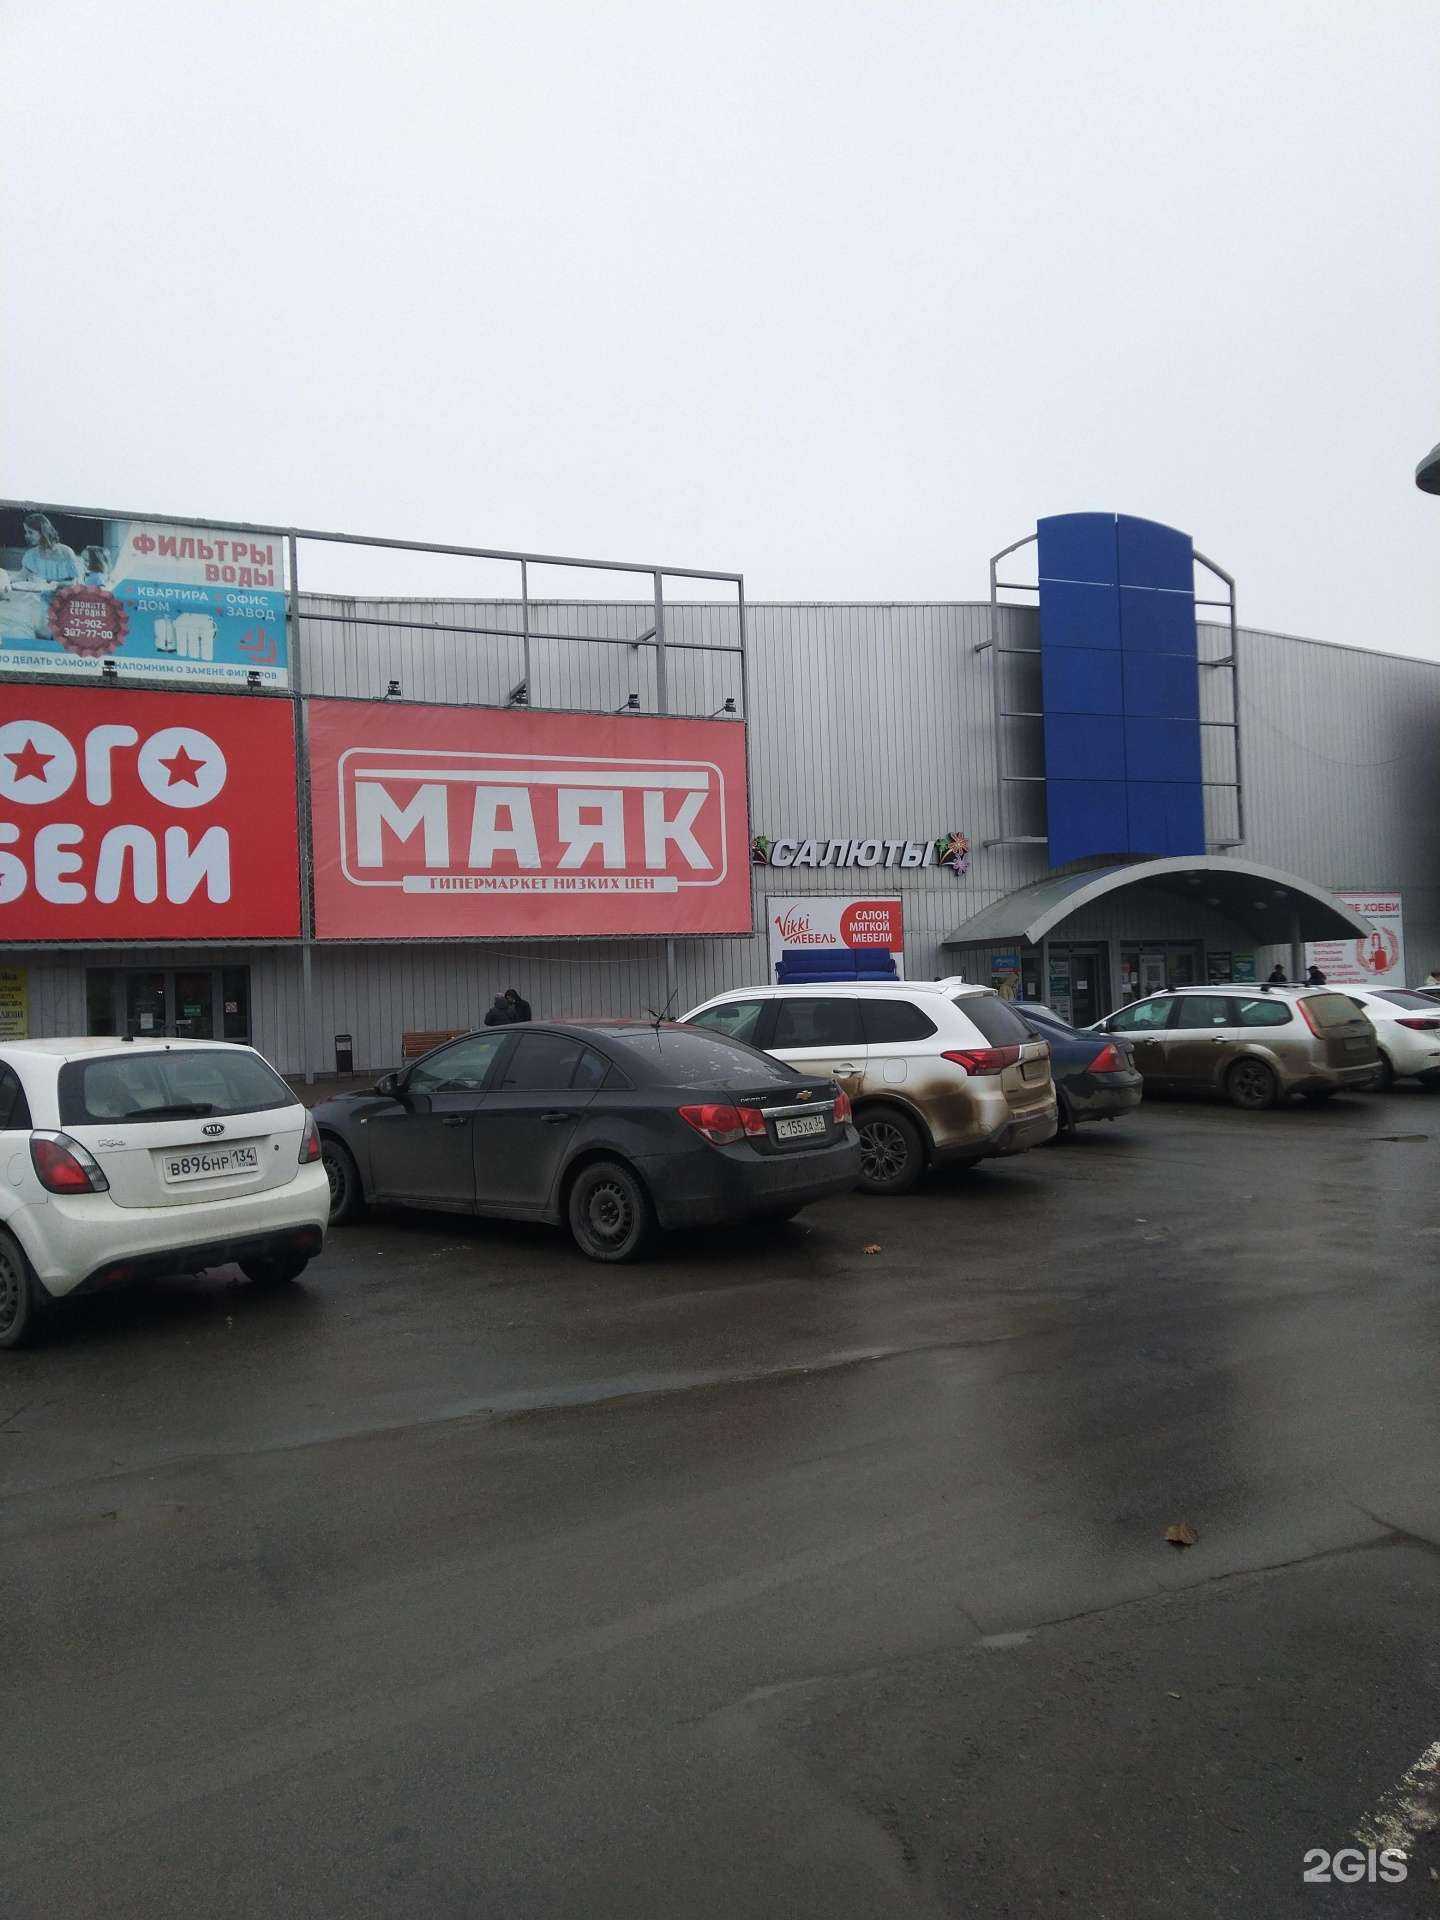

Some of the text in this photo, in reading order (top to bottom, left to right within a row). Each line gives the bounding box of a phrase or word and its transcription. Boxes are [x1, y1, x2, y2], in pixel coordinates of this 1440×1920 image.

[132, 533, 273, 566] ФИЛЬТРЫ
[205, 563, 274, 587] ВОДЫ
[137, 586, 209, 602] КВАРТИРА
[226, 594, 268, 607] ОФИС
[137, 599, 170, 612] ДОМ
[226, 606, 276, 622] ЗАВОД
[12, 656, 51, 666] ДЕЛАТЬ
[55, 659, 99, 669] САМОМУ
[115, 662, 175, 674] НАПОМНИМ
[186, 667, 224, 676] ЗАМЕНЕ
[226, 669, 277, 680] ФИЛРОВ
[355, 782, 713, 869] МАЯК
[771, 839, 936, 867] САЛЮТЫ
[430, 877, 655, 889] ГИПЕРМАРКЕТ НИЗКИХ ЦЕН
[1364, 903, 1400, 912] ХОББИ
[775, 903, 810, 936] Vikki
[855, 911, 889, 920] САЛОН
[849, 920, 890, 932] МЯГКОЙ
[790, 933, 836, 944] МЕБЕЛЬ
[852, 932, 892, 943] МЕБЕЛИ
[204, 1125, 223, 1135] KIA
